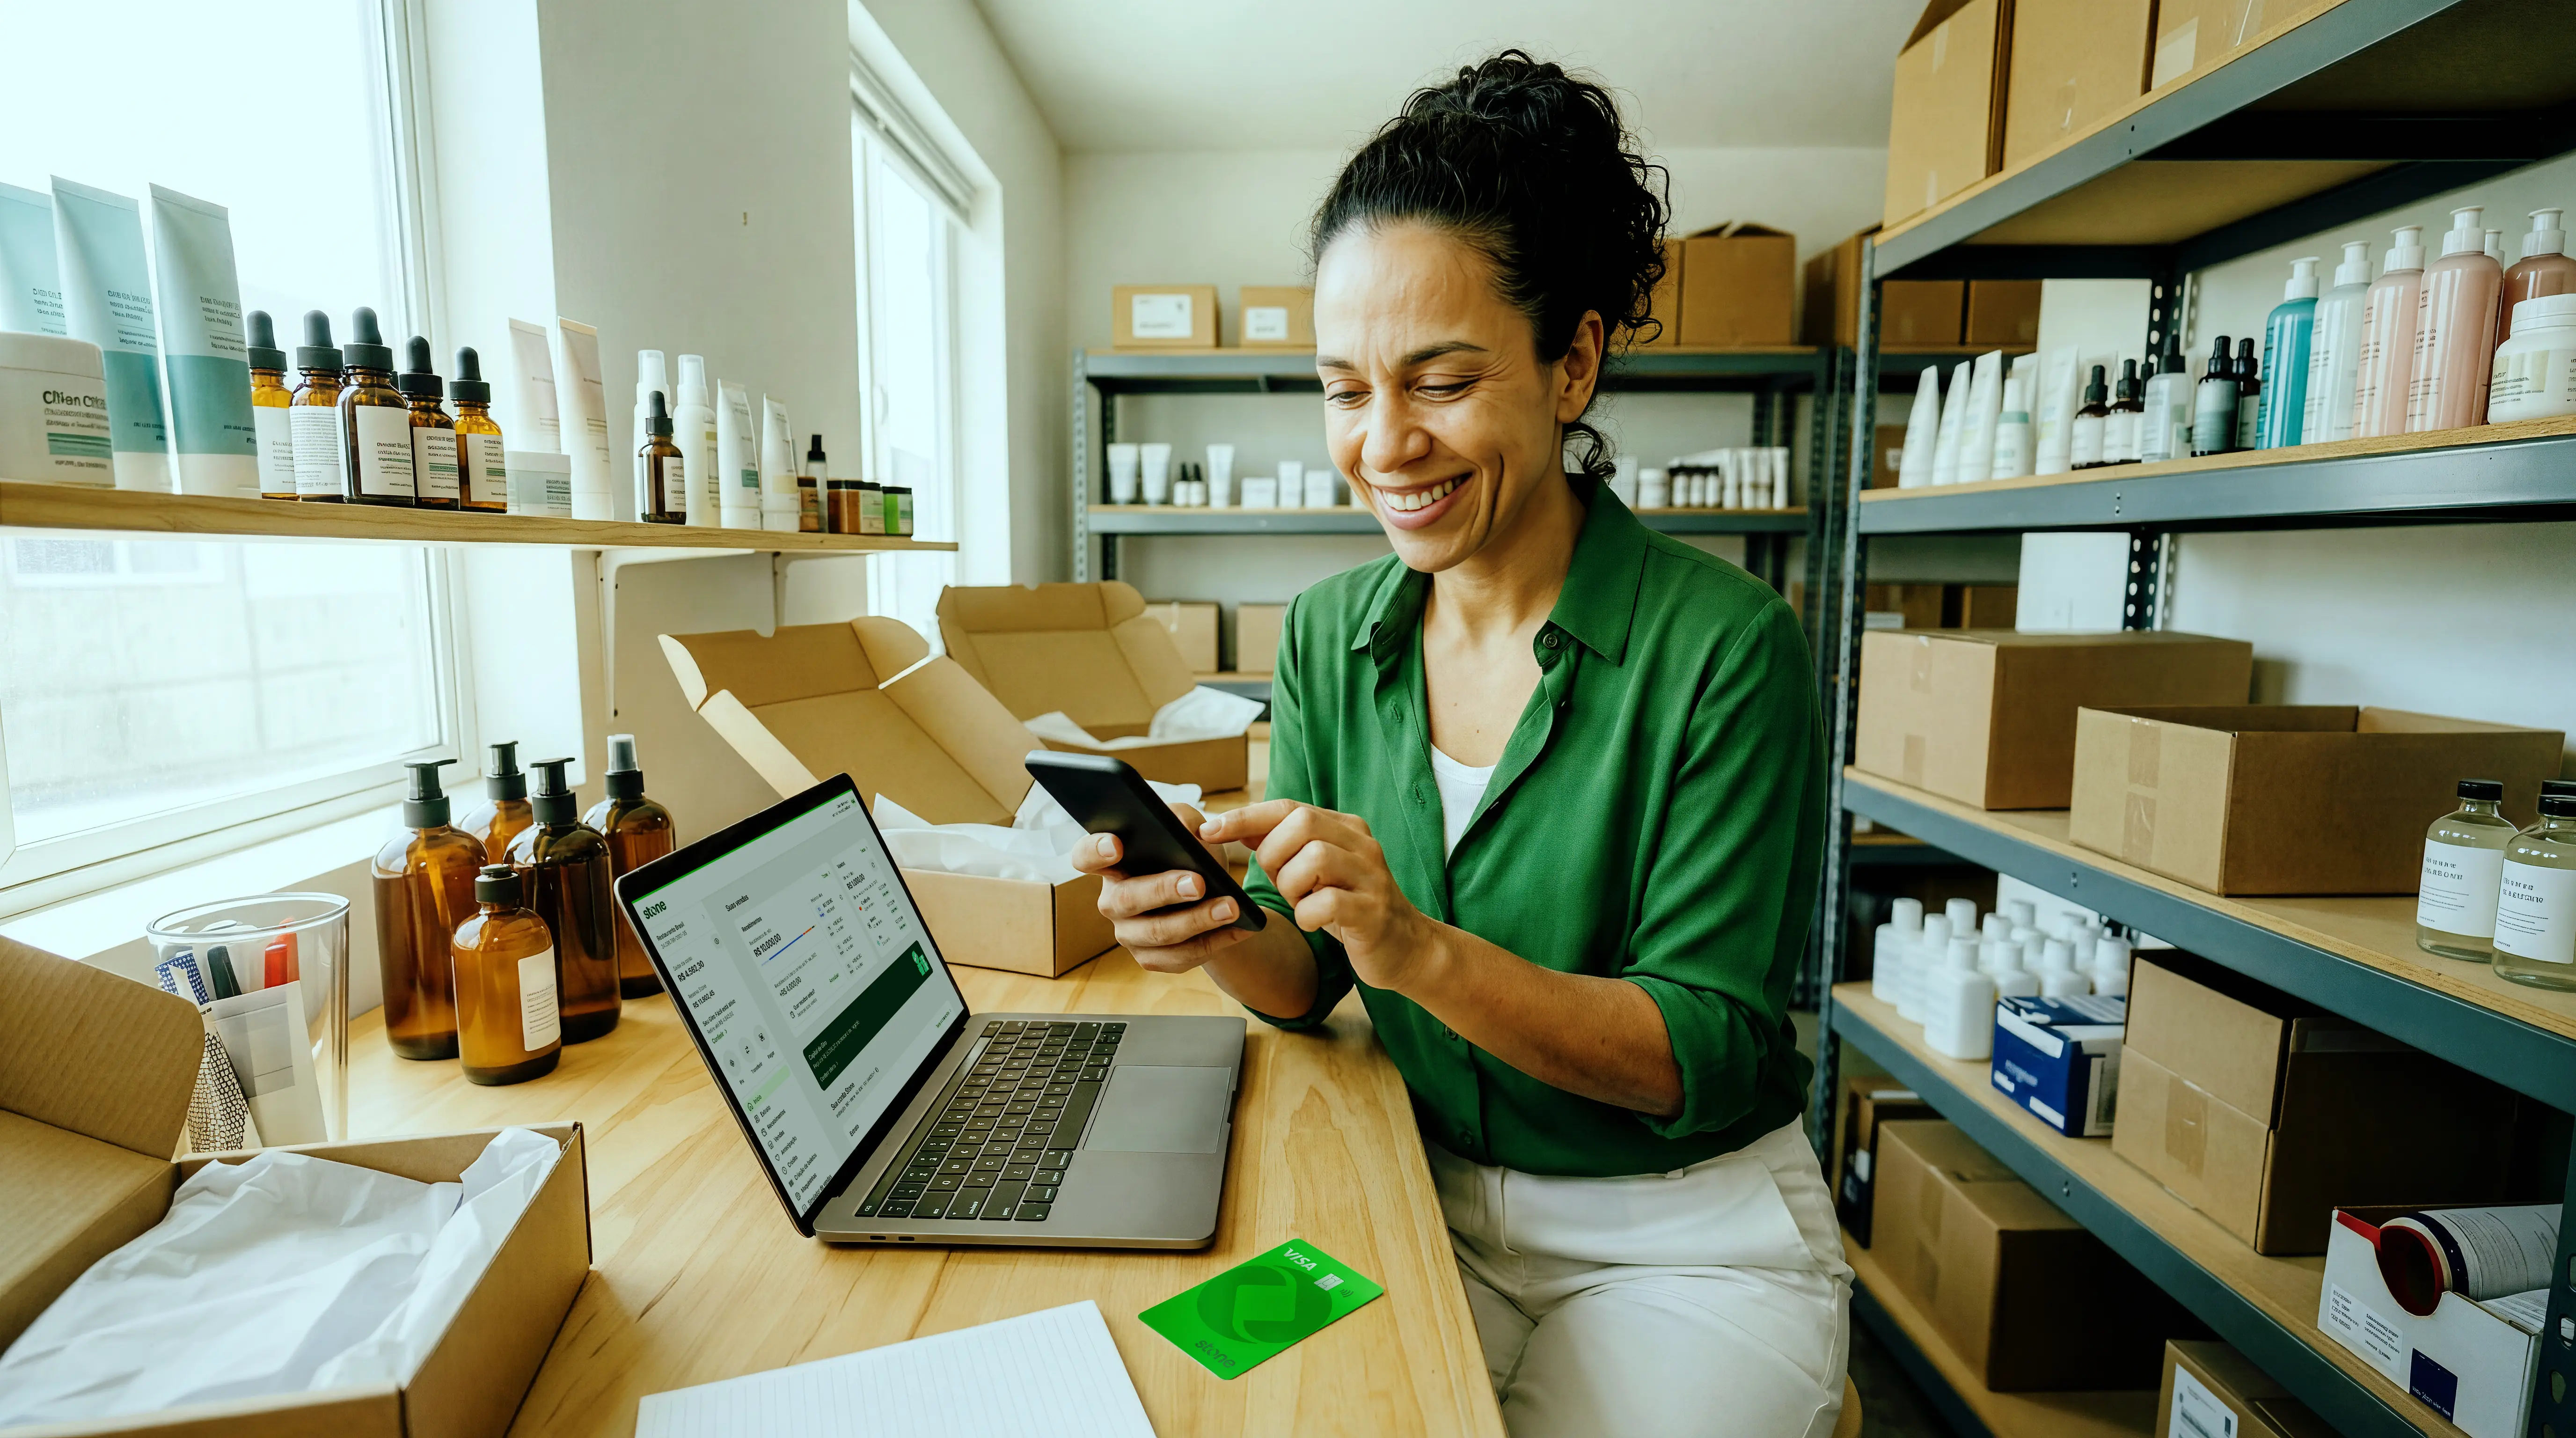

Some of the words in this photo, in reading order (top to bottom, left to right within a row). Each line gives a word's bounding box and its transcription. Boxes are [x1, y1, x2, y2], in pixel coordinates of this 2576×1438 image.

[851, 873, 864, 887] 1.000,00
[643, 901, 666, 919] stone
[725, 903, 736, 911] Suas
[735, 895, 748, 906] vendas
[657, 928, 676, 941] Restaurante
[675, 922, 684, 930] Brasil
[741, 917, 762, 932] Recebimentos
[754, 947, 761, 957] R$
[760, 933, 781, 952] 10.000,00
[678, 973, 686, 982] R$
[685, 961, 704, 977] 4.562,30
[786, 976, 801, 991] 4.000,00
[698, 990, 715, 1005] 11.902,45
[712, 1032, 724, 1043] Conferir
[809, 1049, 819, 1060] Capital
[751, 1062, 762, 1073] Transferir
[838, 1092, 847, 1103] conta
[845, 1083, 855, 1094] Stone
[760, 1106, 770, 1117] Extrato
[767, 1109, 785, 1130] Recebimentos
[774, 1130, 784, 1142] Vendas
[849, 1125, 859, 1137] Extrato
[781, 1137, 797, 1155] Antecipação
[788, 1156, 798, 1167] Crédito
[794, 1168, 805, 1180] Criação
[807, 1153, 817, 1165] boletos
[801, 1174, 817, 1193] Maquininhas
[1283, 1247, 1317, 1271] VISA
[1195, 1338, 1236, 1368] stone
